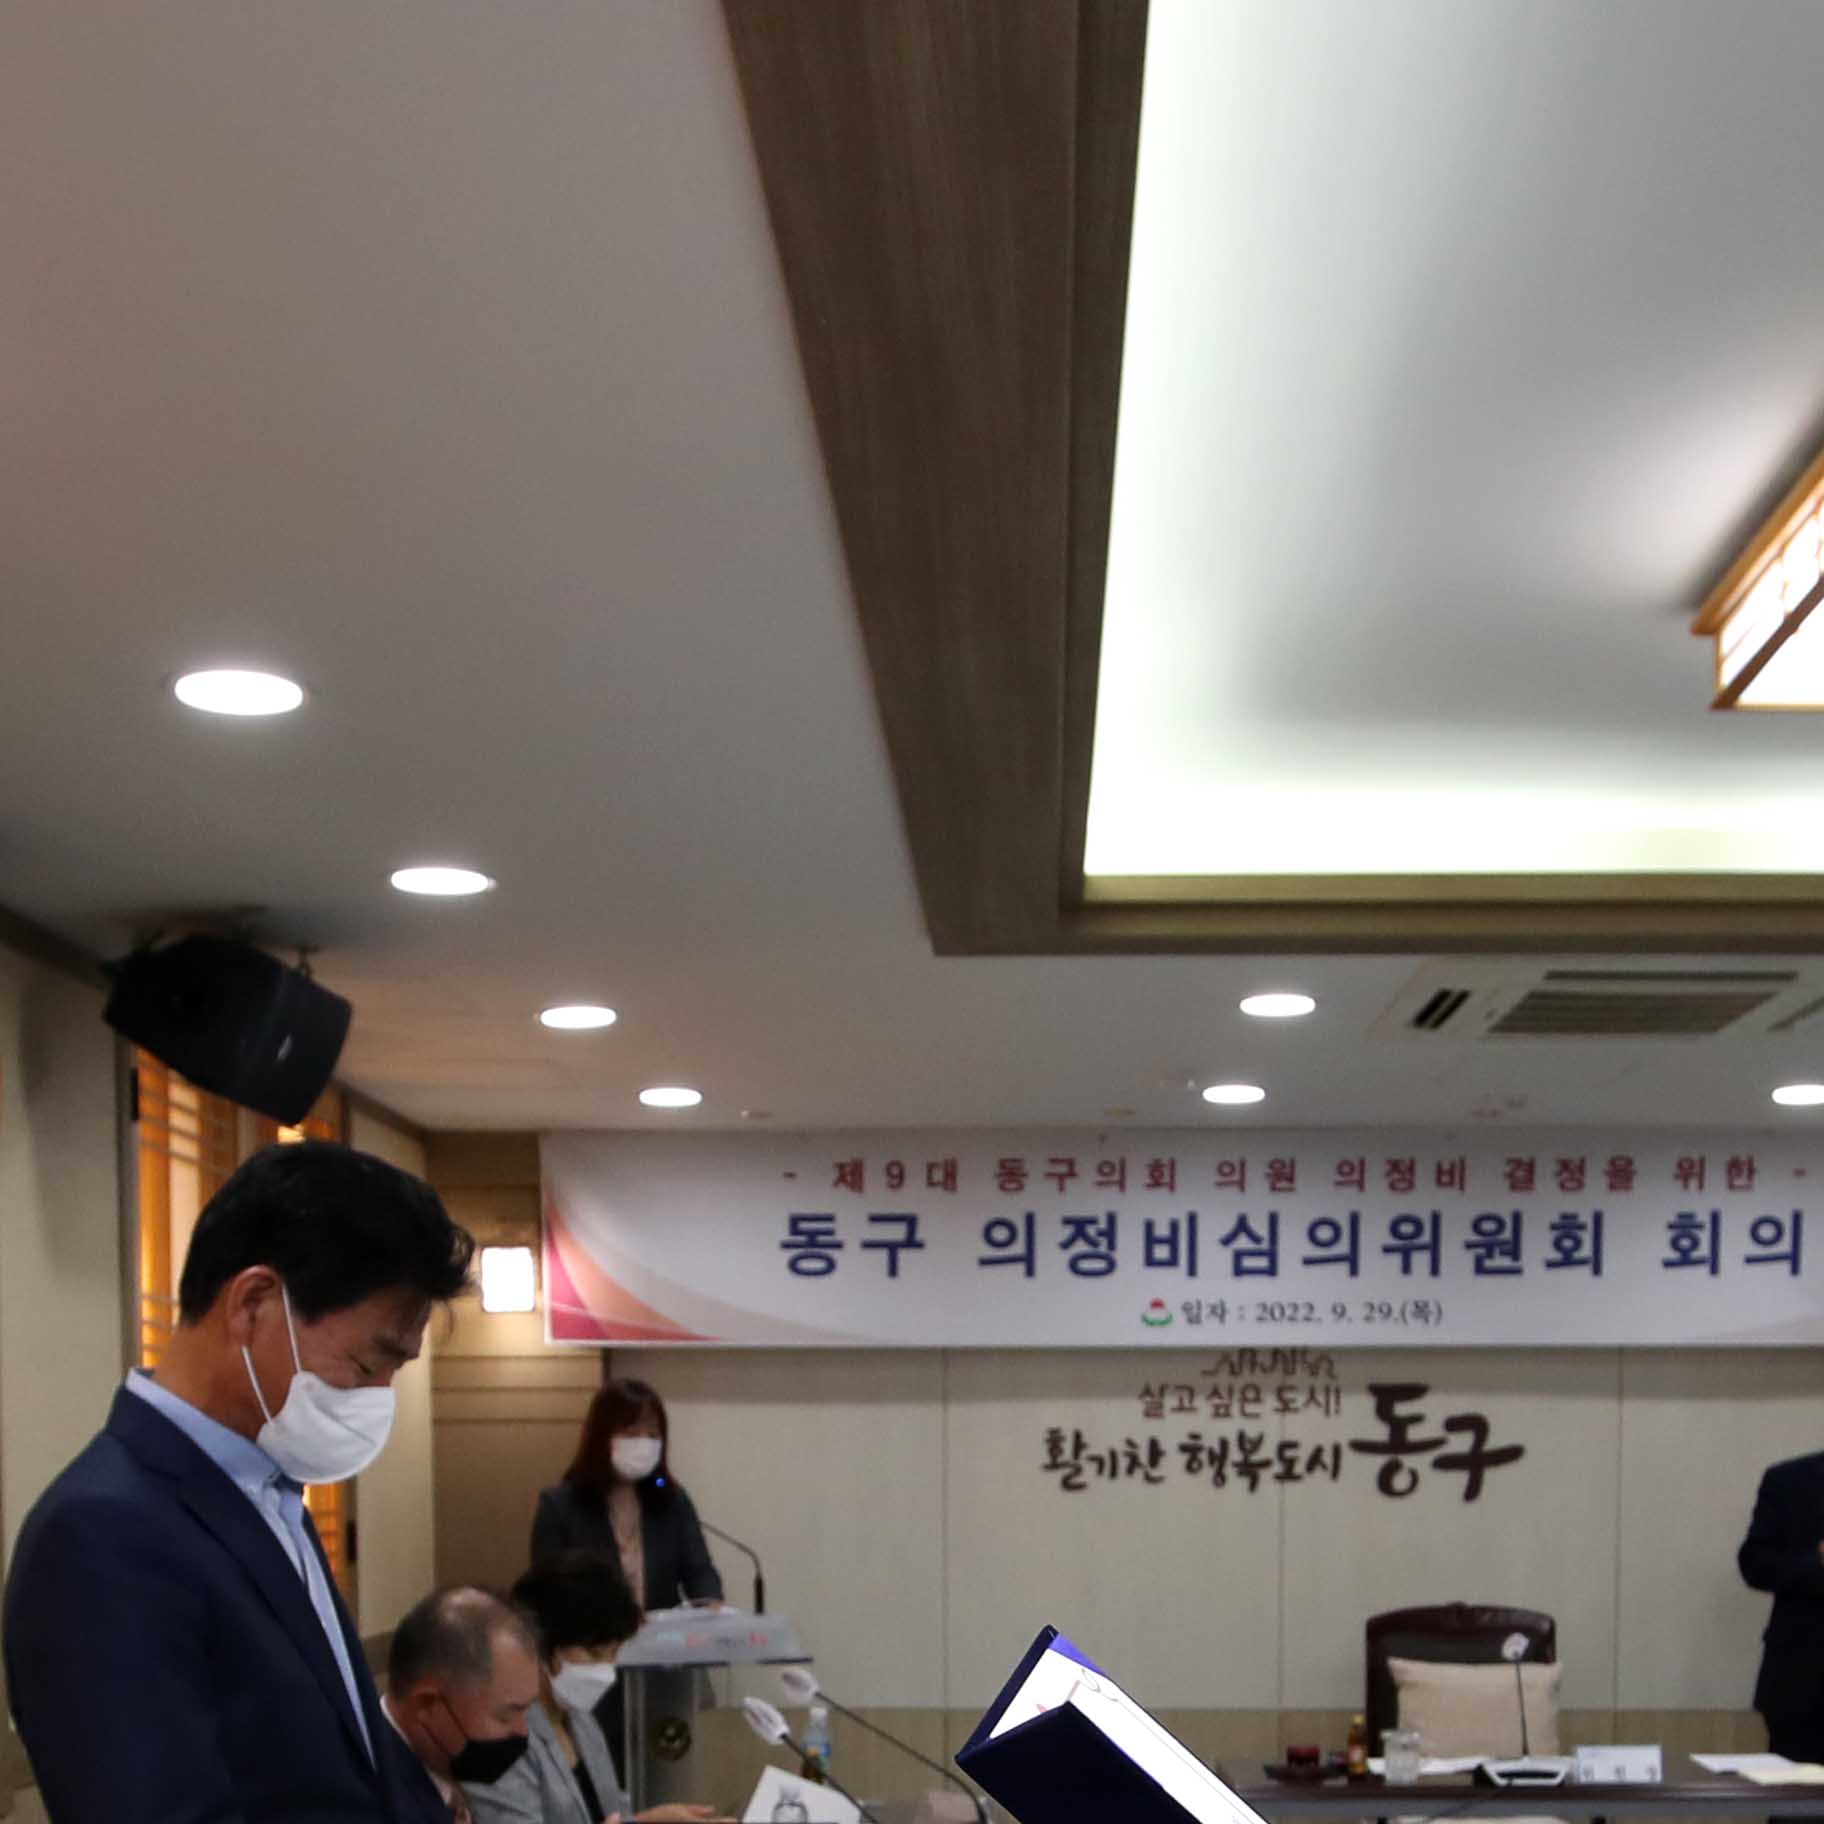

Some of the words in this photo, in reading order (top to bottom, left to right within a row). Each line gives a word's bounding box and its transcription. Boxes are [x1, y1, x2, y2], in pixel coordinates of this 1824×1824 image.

[832, 1157, 960, 1194] 제9대
[993, 1157, 1179, 1194] 동구의회
[1213, 1157, 1299, 1194] 의원
[1334, 1156, 1468, 1194] 의정비
[1502, 1155, 1639, 1193] 결정을
[1672, 1155, 1758, 1193] 위한
[778, 1211, 927, 1280] 동구
[976, 1209, 1605, 1280] 의정비심의위원회
[1660, 1208, 1805, 1279] 회의
[1180, 1299, 1229, 1326] 일자
[1137, 1382, 1200, 1420] 살고
[1204, 1382, 1266, 1420] 싶은
[1272, 1383, 1343, 1419] 도시!
[1041, 1428, 1168, 1493] 활기찬
[1178, 1429, 1343, 1493] 행복도시
[1348, 1381, 1527, 1502] 동구
